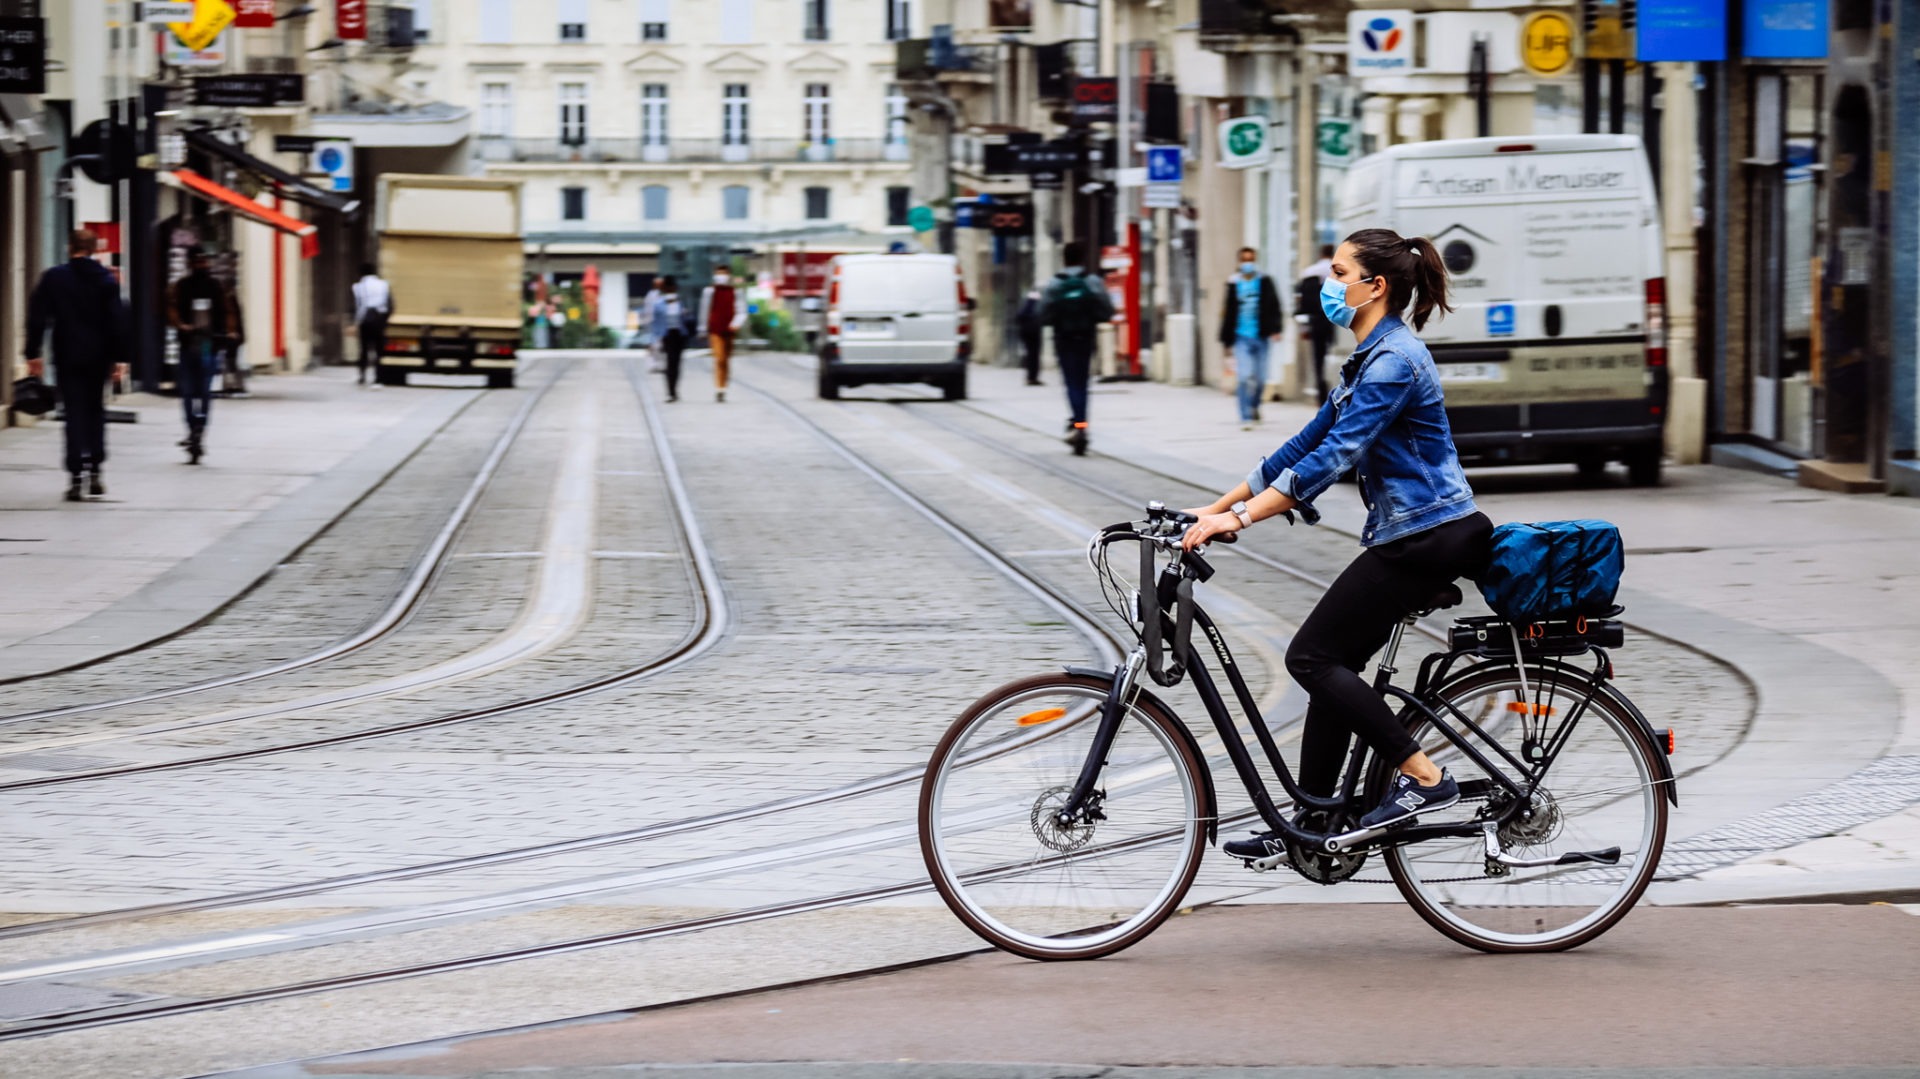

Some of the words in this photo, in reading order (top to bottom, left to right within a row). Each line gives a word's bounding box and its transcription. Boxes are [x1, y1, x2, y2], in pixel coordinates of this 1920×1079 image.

[1411, 168, 1496, 195] Artisan
[1504, 163, 1627, 192] Menuisier
[1395, 790, 1426, 812] N
